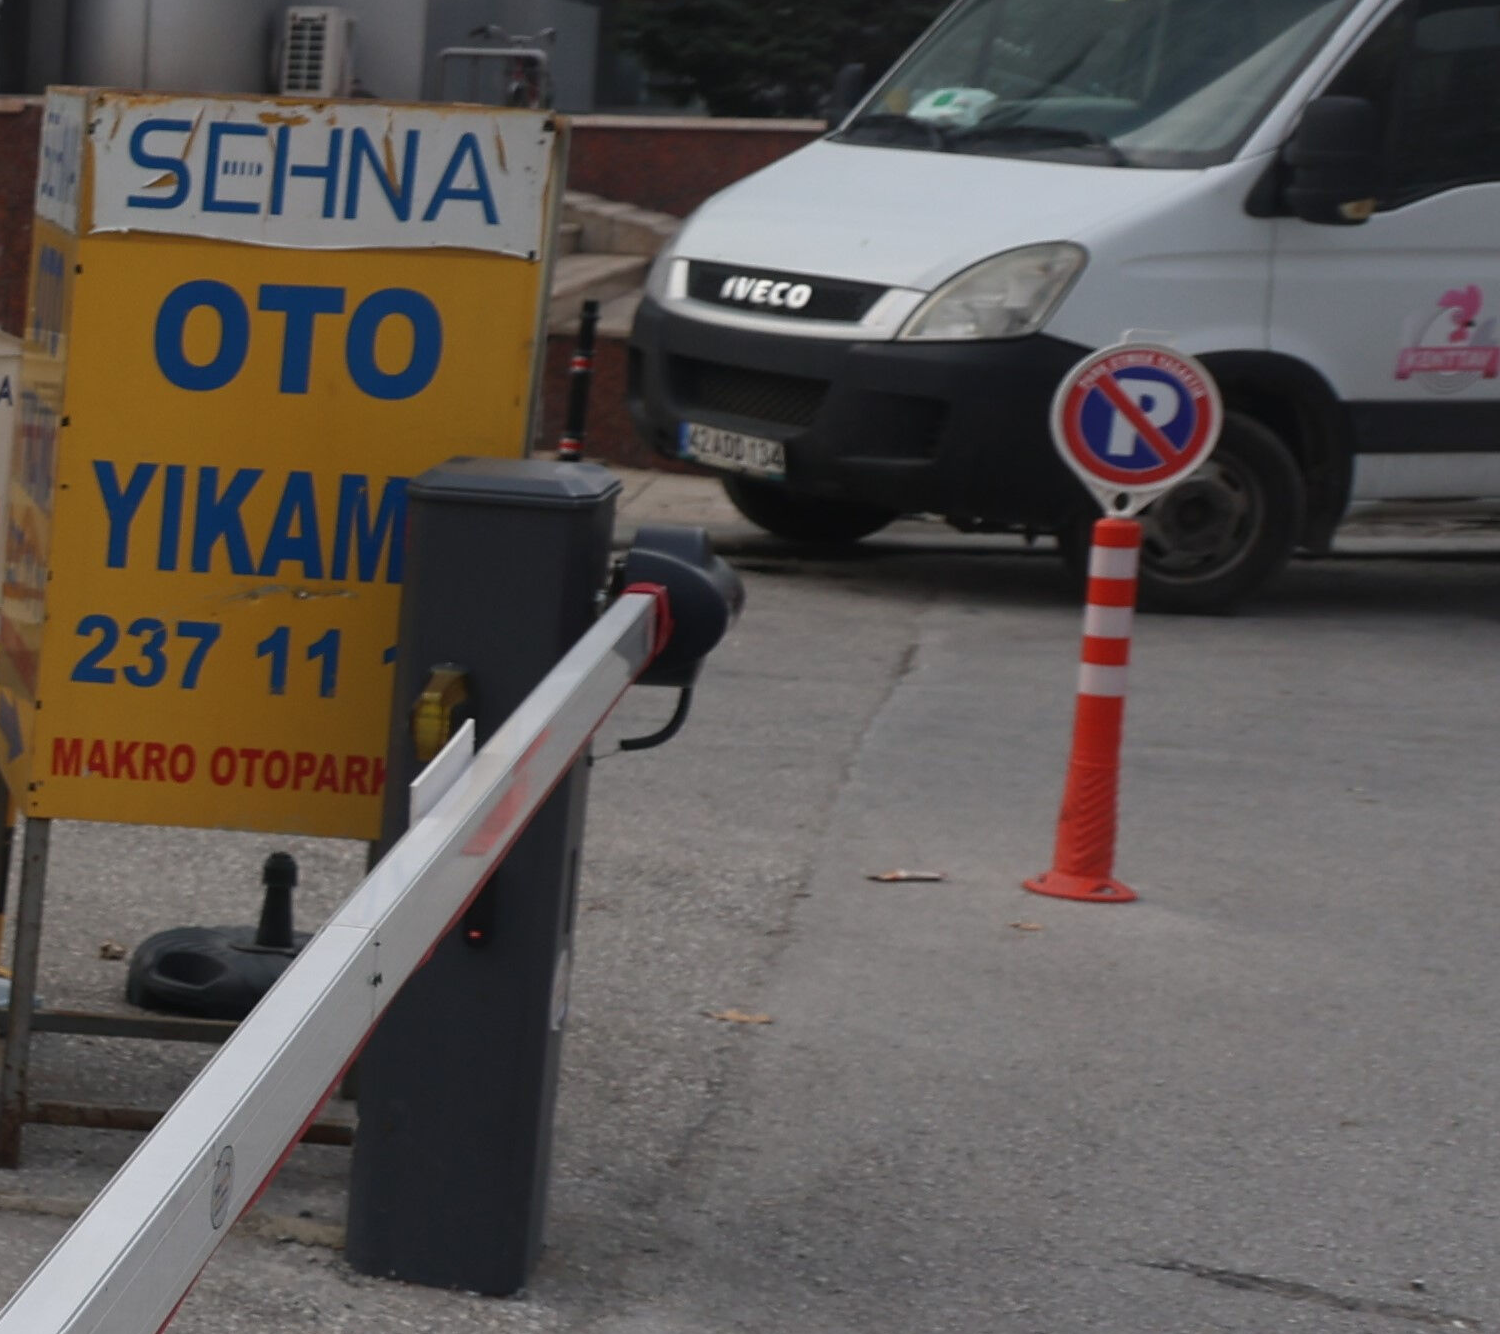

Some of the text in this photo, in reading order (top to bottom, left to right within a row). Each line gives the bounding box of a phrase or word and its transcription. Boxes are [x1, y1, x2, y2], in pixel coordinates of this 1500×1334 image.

[127, 118, 499, 225] SEHNA
[720, 275, 812, 309] IVECO
[153, 278, 443, 401] OTO
[70, 613, 341, 698] 237 11
[51, 737, 197, 784] MAKRO
